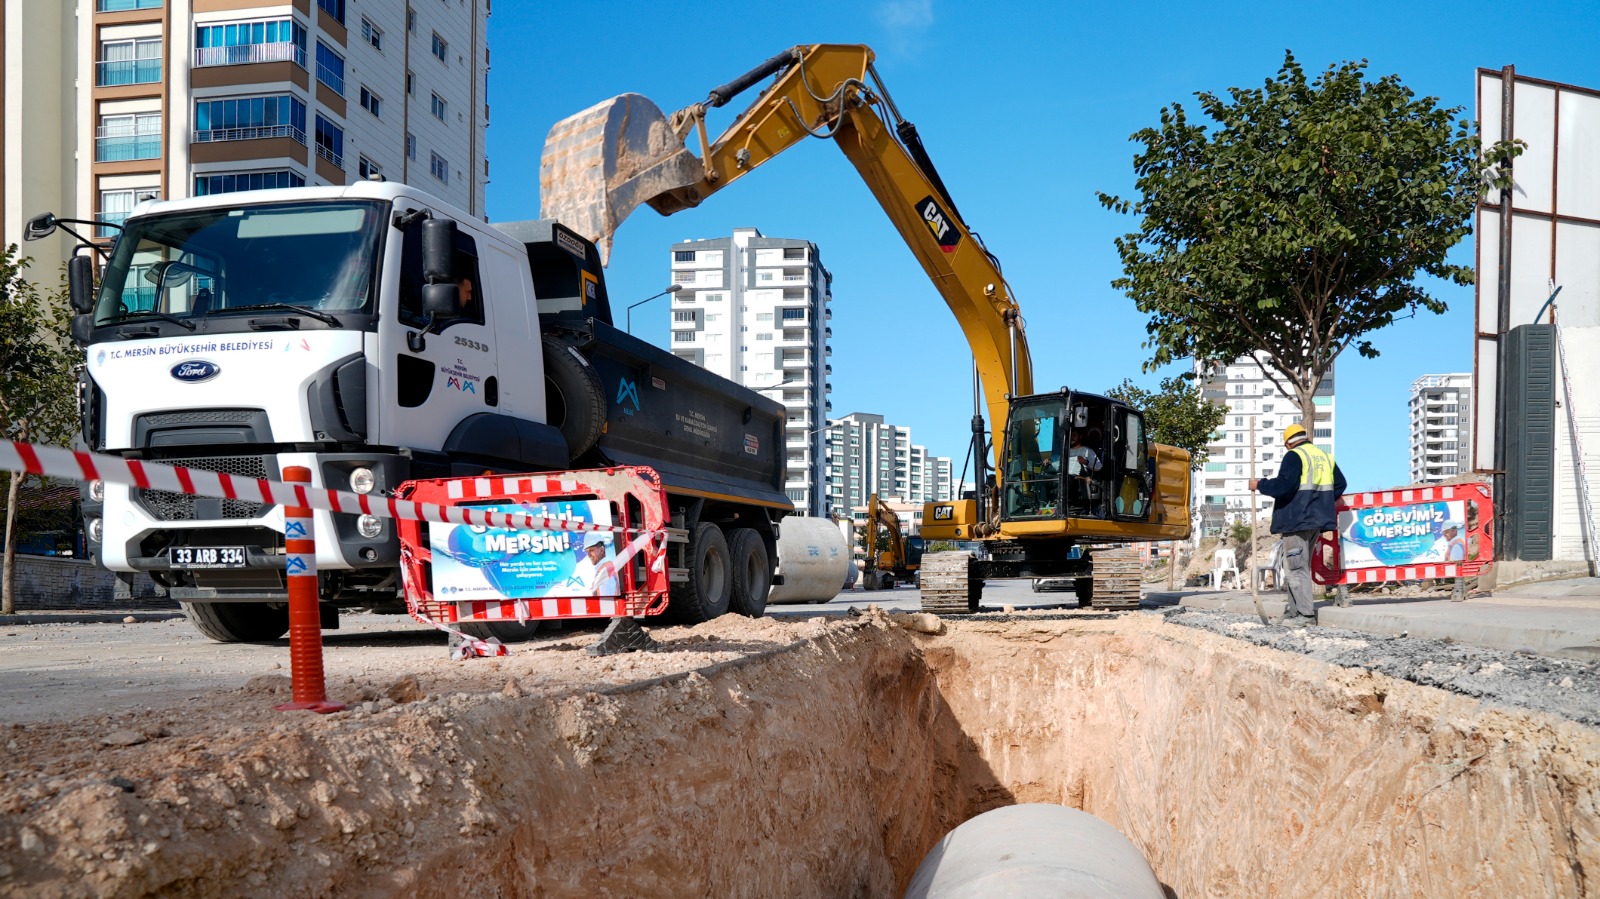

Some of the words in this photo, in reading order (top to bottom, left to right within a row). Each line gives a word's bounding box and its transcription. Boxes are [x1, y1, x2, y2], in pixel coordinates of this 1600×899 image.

[924, 201, 950, 240] CAT
[110, 351, 122, 359] T.C.
[124, 345, 156, 357] MERSİN
[159, 341, 217, 355] BÜYÜKŞEHİR
[220, 339, 273, 352] BELEDİYESİ
[178, 363, 206, 377] Ford
[935, 506, 952, 520] CAT
[1363, 505, 1444, 526] GÖREVİMİZ
[1373, 522, 1431, 538] MERSİN!
[485, 531, 570, 554] MERSİN!
[177, 549, 192, 563] 33
[195, 549, 217, 563] ARB
[221, 549, 242, 563] 334
